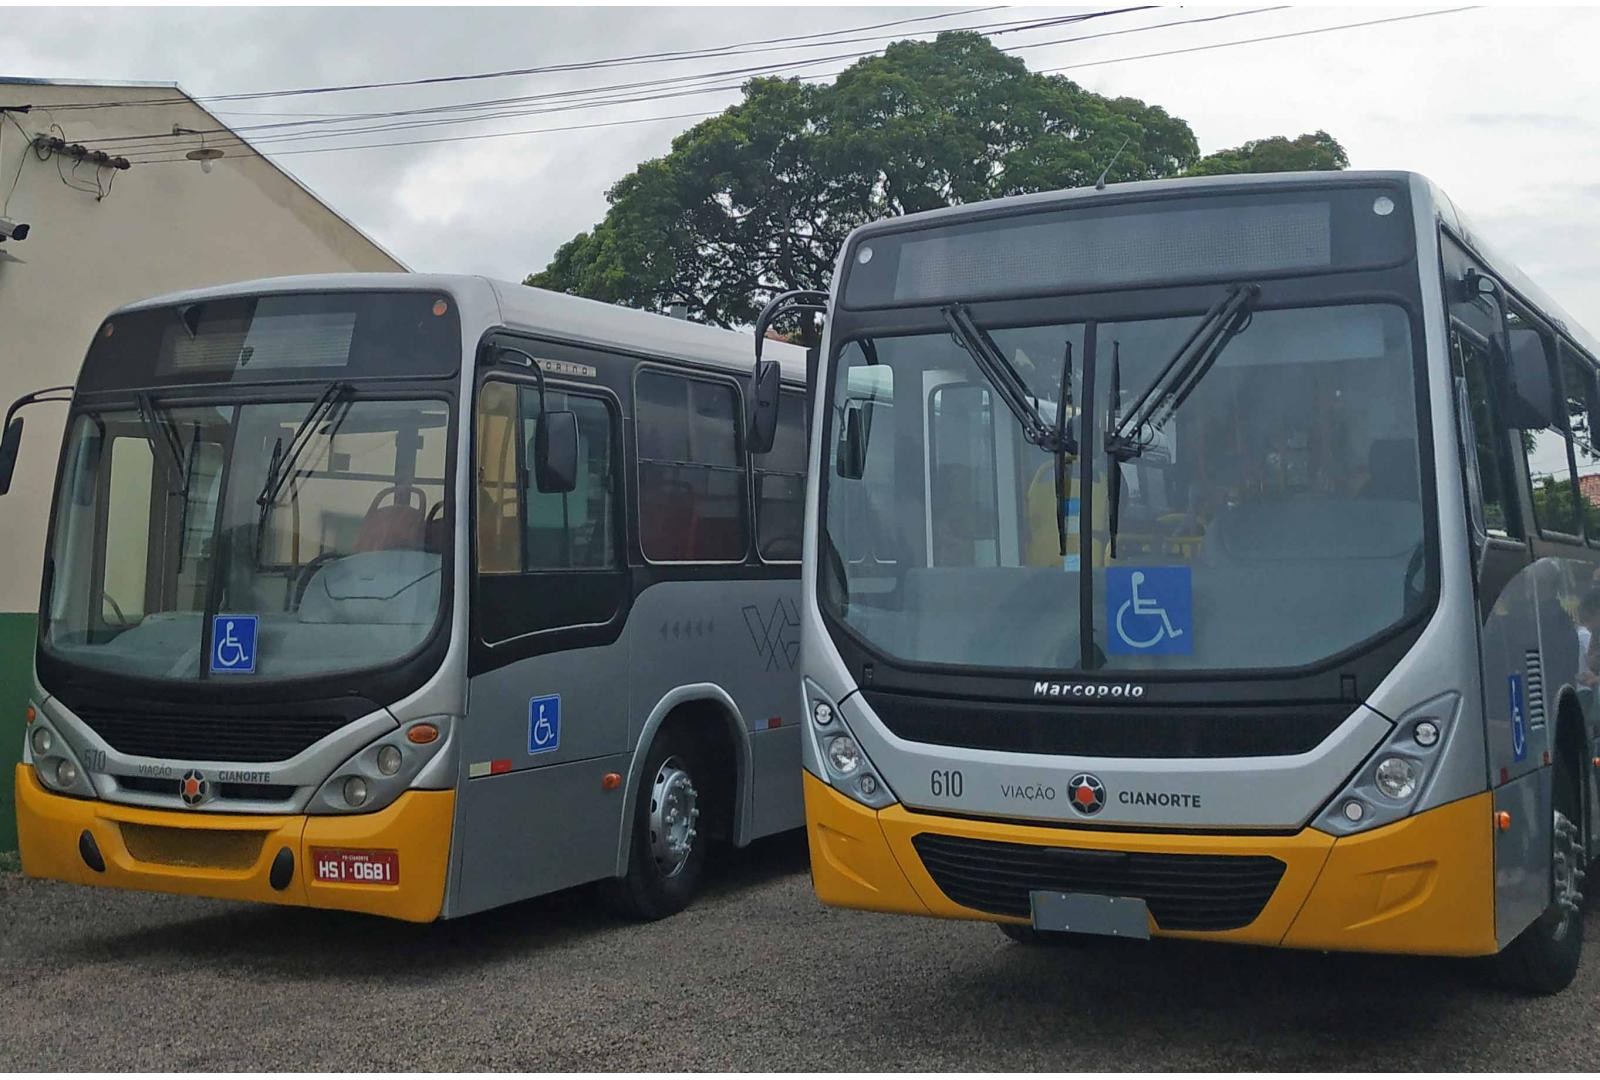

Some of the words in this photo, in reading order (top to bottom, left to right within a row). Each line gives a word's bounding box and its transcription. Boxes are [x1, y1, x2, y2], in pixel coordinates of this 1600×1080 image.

[537, 360, 588, 375] ORINO
[1033, 681, 1144, 699] Marcopolo
[85, 750, 107, 771] 570
[138, 764, 173, 777] VIAÇÃO
[218, 771, 271, 783] CIANORTE
[931, 769, 963, 797] 610
[1000, 782, 1056, 801] VIAÇÃO
[1118, 791, 1202, 808] CIANORTE
